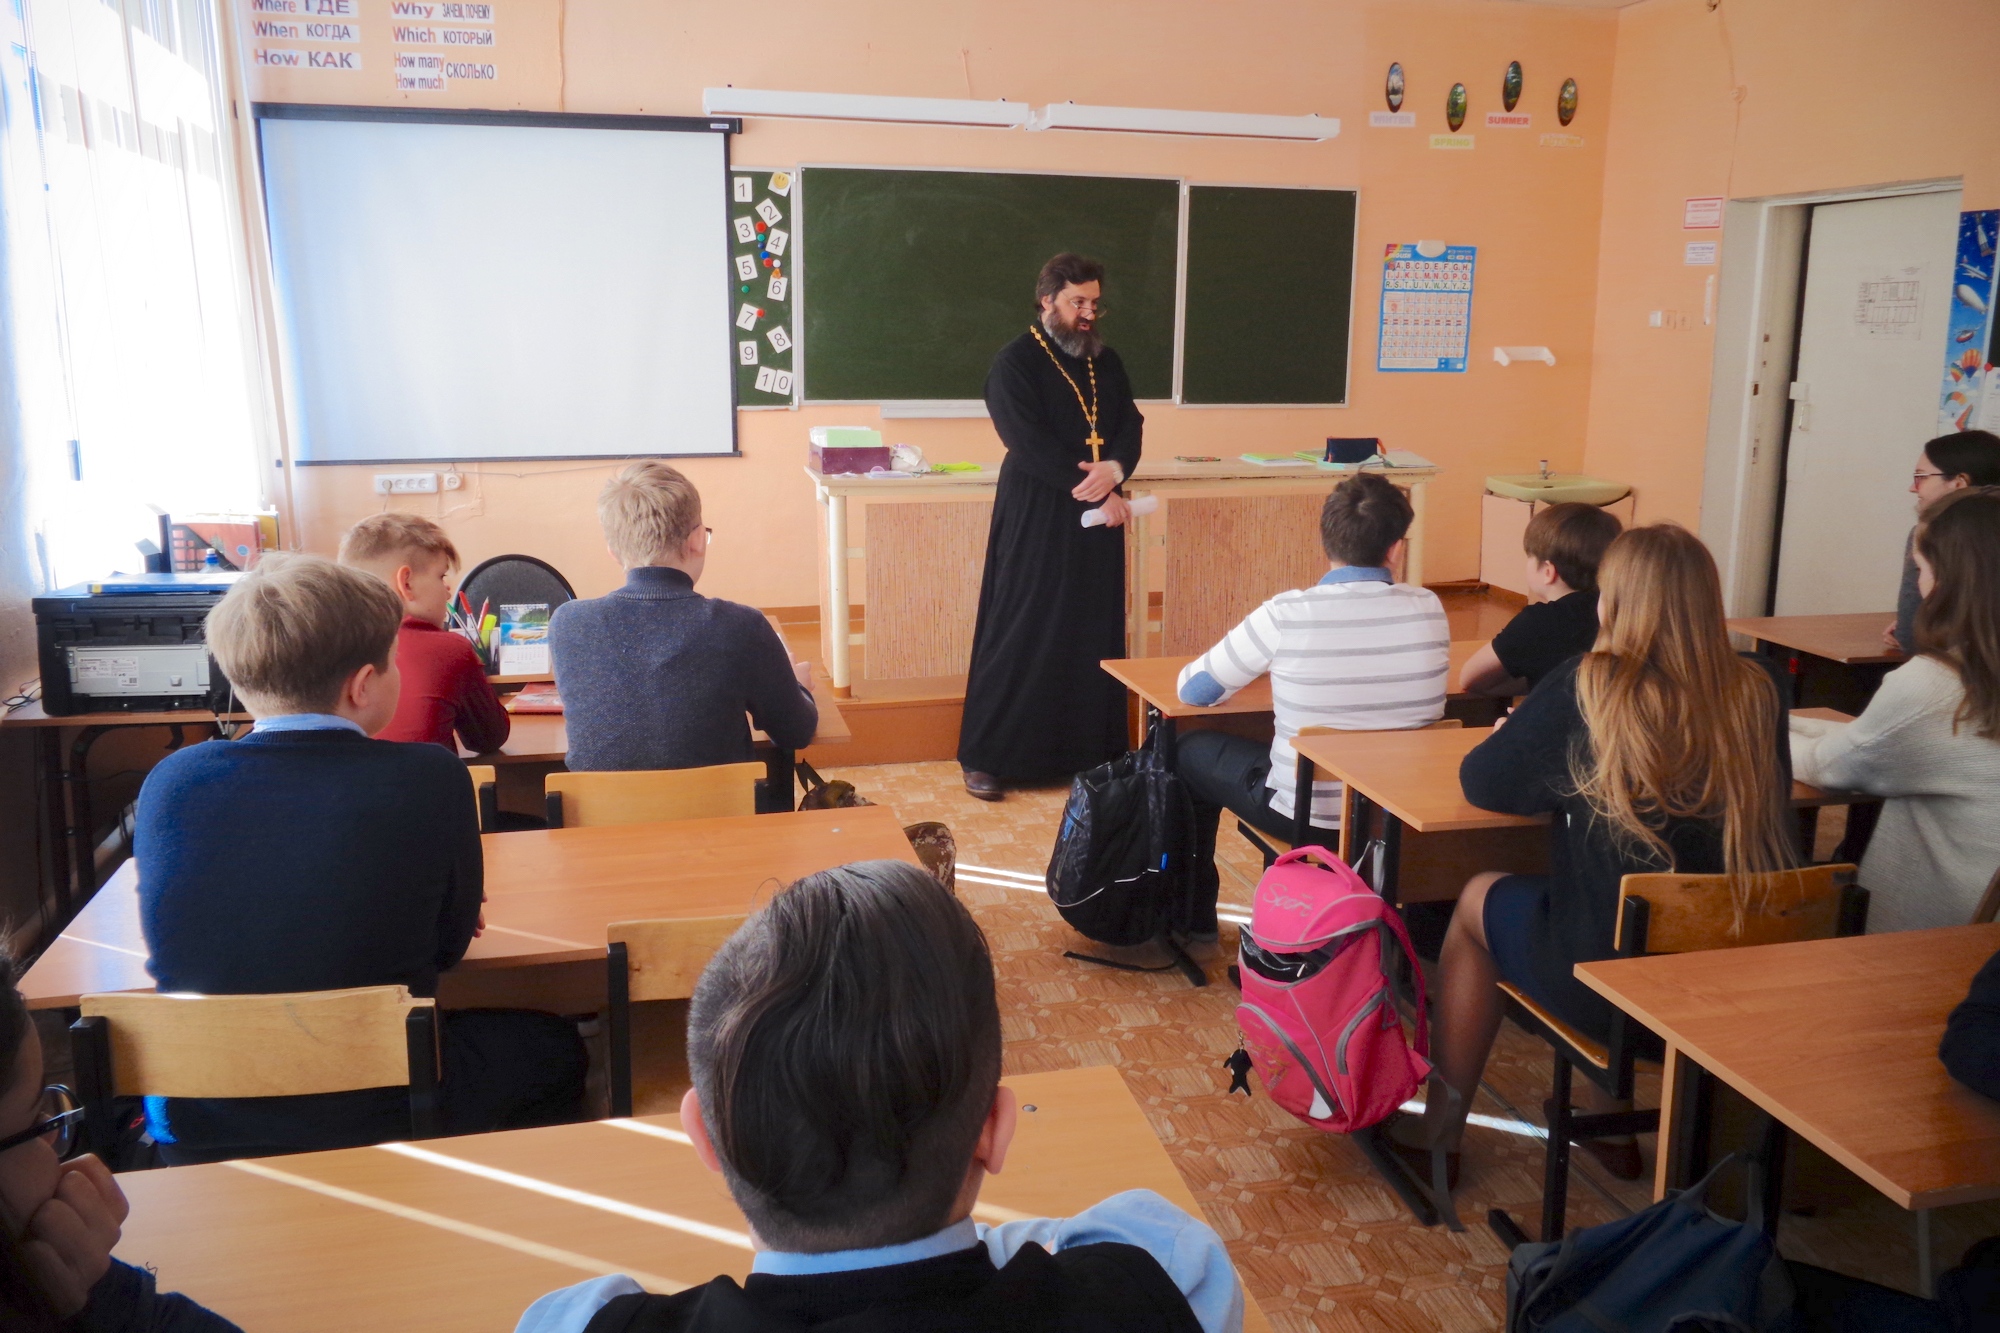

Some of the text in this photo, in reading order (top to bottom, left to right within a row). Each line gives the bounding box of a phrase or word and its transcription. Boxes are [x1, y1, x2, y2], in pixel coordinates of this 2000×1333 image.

[251, 0, 297, 13] Where
[305, 0, 350, 15] ГДЕ
[391, 1, 434, 19] Why
[465, 4, 490, 19] ПОЧЕМУ
[252, 20, 299, 38] When
[306, 23, 351, 40] КОГДА
[392, 26, 437, 43] Which
[443, 29, 493, 45] КОТОРЫЙ
[253, 48, 299, 66] How
[308, 51, 353, 69] КАК
[394, 52, 445, 73] How many
[446, 62, 495, 80] СКОЛЬКО
[395, 73, 445, 90] How much
[1488, 116, 1529, 125] SUMMER
[1434, 138, 1470, 147] SPRING
[739, 183, 746, 198] 1
[763, 205, 778, 221] 2
[740, 223, 751, 238] 3
[771, 236, 782, 250] 4
[742, 261, 752, 275] 5
[772, 280, 782, 295] 6
[743, 311, 754, 325] 7
[774, 333, 786, 347] 8
[744, 346, 754, 360] 9
[1263, 883, 1315, 918] Sport
